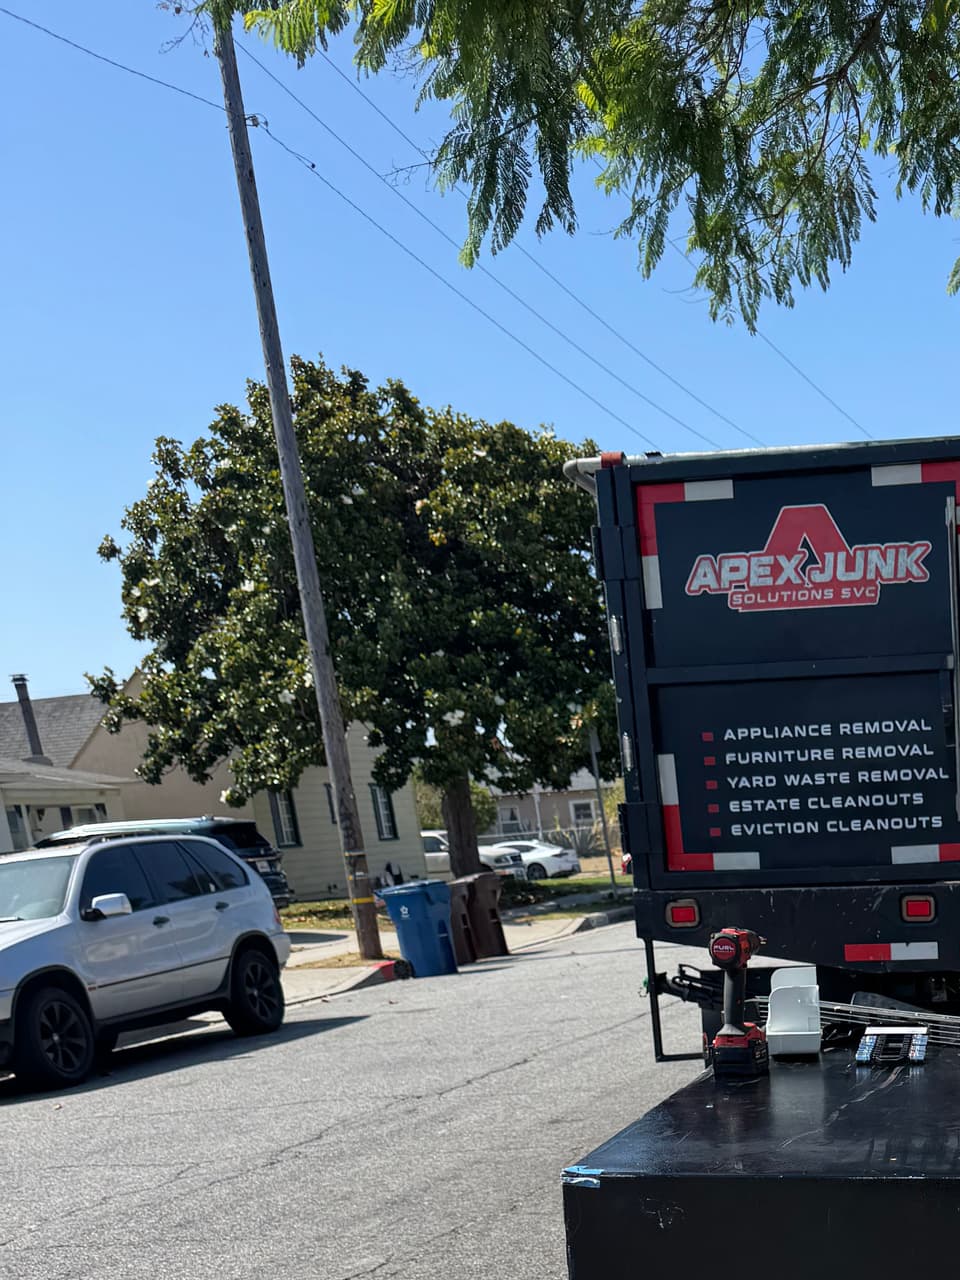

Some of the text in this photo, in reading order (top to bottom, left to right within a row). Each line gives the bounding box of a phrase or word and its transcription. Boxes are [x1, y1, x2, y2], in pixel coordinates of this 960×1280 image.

[688, 546, 929, 592] APEX JUNK
[732, 585, 876, 605] SOLUTIONS SVC
[724, 719, 932, 741] APPLIANCE REMOVAL
[725, 744, 934, 765] FURNITURE REMOVAL
[727, 768, 949, 789] YARD WASTE REMOVAL
[729, 793, 924, 813] ESTATE CLEANOUTS
[731, 816, 943, 836] EVICTION CLEANOUTS
